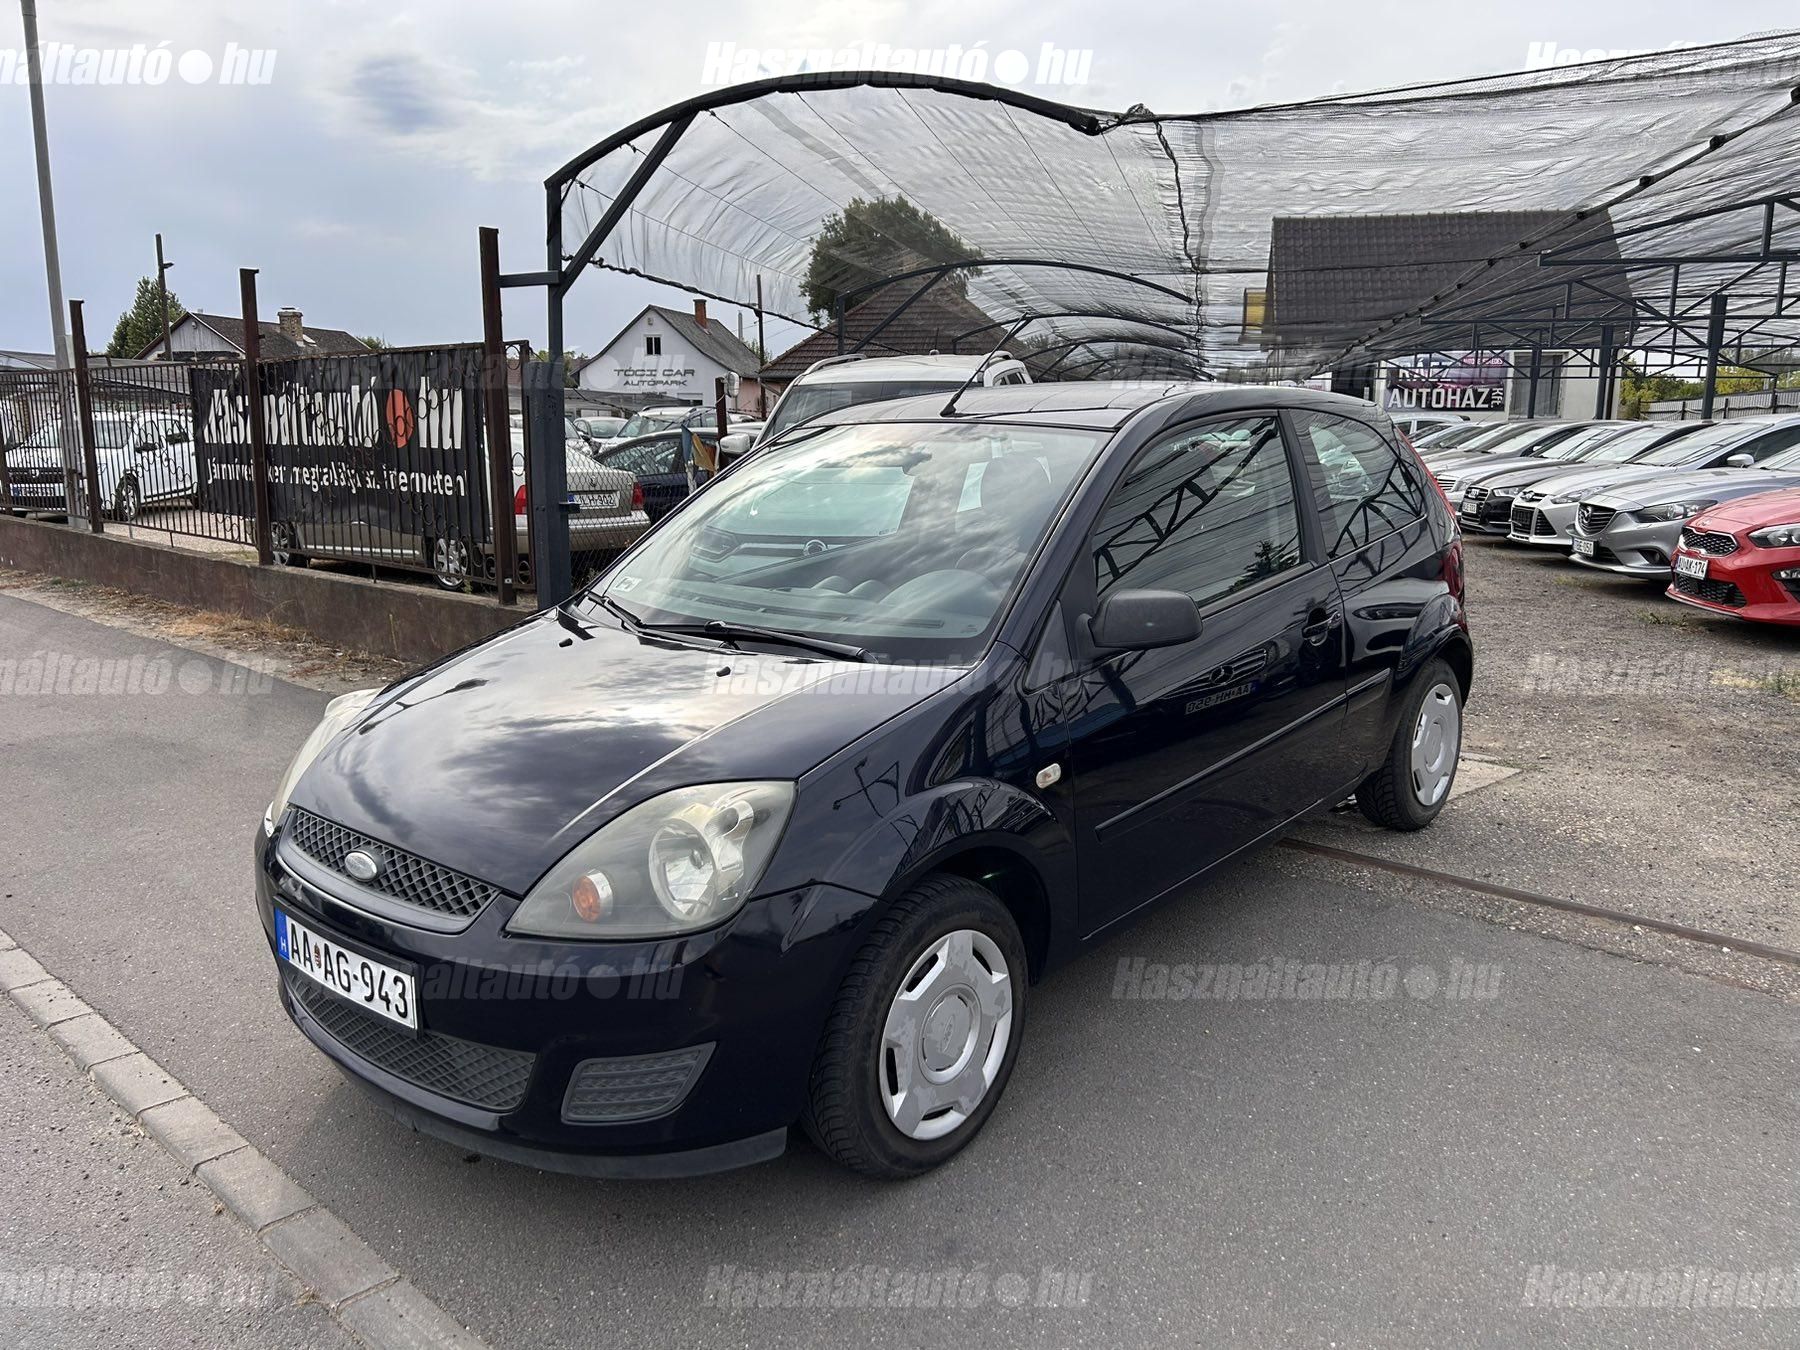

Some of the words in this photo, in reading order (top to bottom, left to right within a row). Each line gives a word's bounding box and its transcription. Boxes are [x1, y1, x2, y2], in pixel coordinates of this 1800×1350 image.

[623, 378, 687, 386] AUTÓPARK
[662, 368, 695, 377] CAR
[1388, 384, 1490, 408] AUTÓHÁZ
[1491, 387, 1504, 408] Kft.
[418, 377, 463, 449] hu
[279, 935, 287, 953] H
[323, 943, 408, 1019] AG-943
